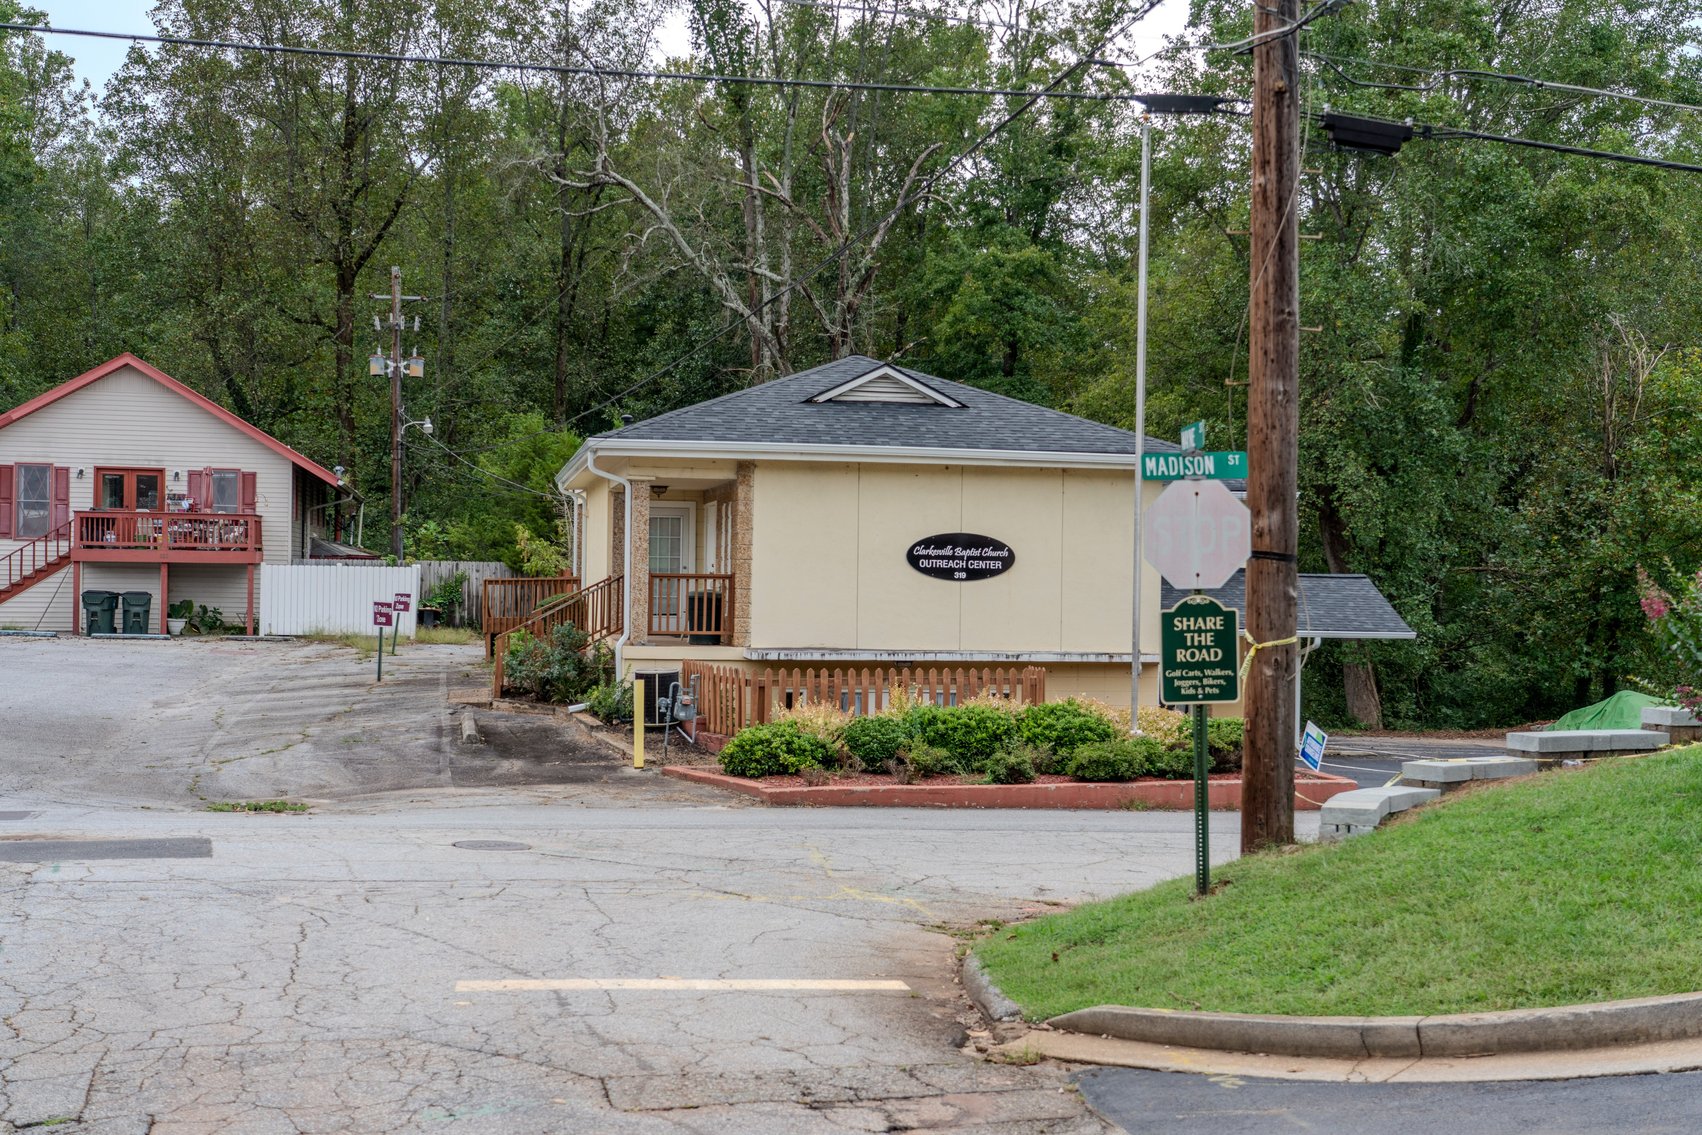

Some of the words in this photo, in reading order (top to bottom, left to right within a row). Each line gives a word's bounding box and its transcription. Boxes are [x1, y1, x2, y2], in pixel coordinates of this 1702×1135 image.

[1145, 455, 1215, 477] MADISON
[1227, 454, 1240, 465] ST
[1152, 515, 1242, 554] STOP
[913, 545, 953, 556] Clarkesville
[954, 547, 981, 560] Baptist
[981, 546, 1009, 558] Church
[919, 559, 966, 569] OUTREACH
[968, 560, 1002, 569] CENTER
[1173, 616, 1224, 631] SHARE
[1184, 632, 1215, 646] THE
[1176, 648, 1223, 662] ROAD
[1165, 669, 1182, 677] Golf
[1182, 669, 1203, 677] Carts,
[1204, 668, 1234, 677] Walkers,
[1174, 679, 1201, 687] Joggers,
[1181, 687, 1196, 695] Kids
